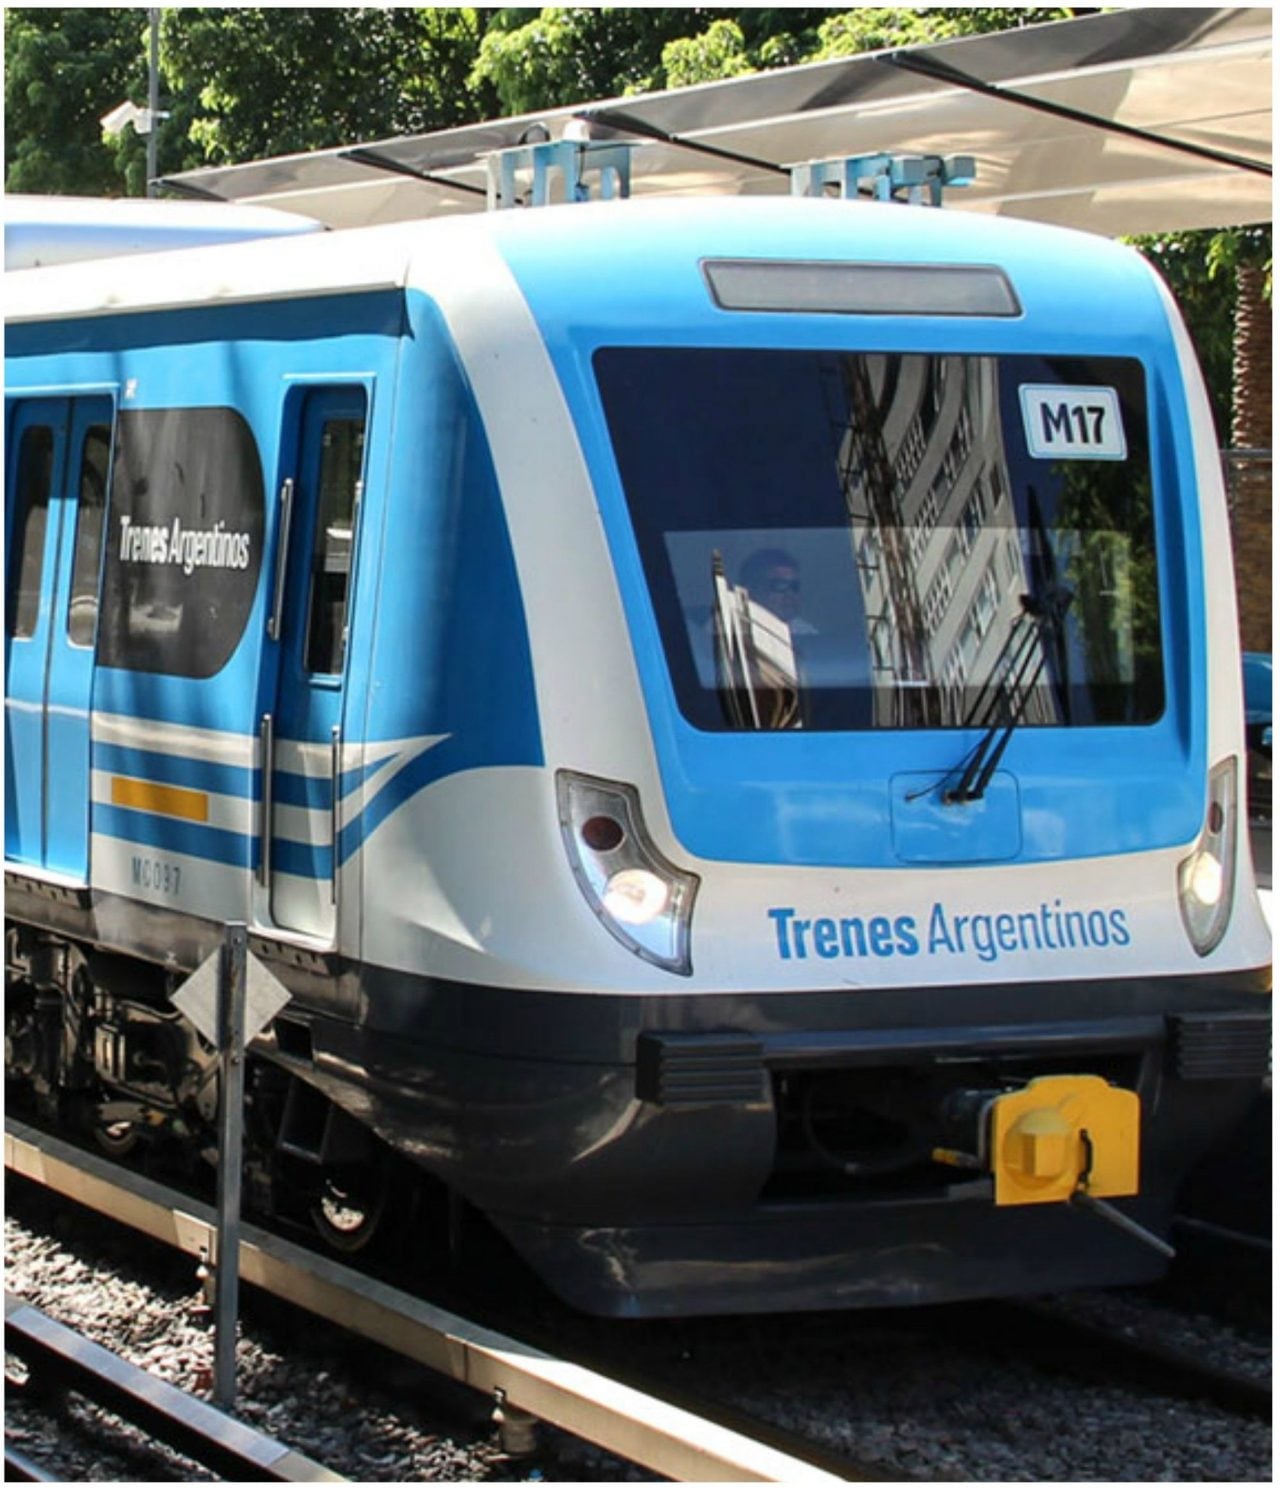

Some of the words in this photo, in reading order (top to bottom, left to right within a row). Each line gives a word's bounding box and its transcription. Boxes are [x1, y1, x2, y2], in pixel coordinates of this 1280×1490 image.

[1039, 402, 1106, 444] M17
[119, 515, 168, 562] Trenes
[168, 517, 250, 575] Argentinos
[768, 906, 918, 960] Trenes
[927, 899, 1130, 961] Argentinos
